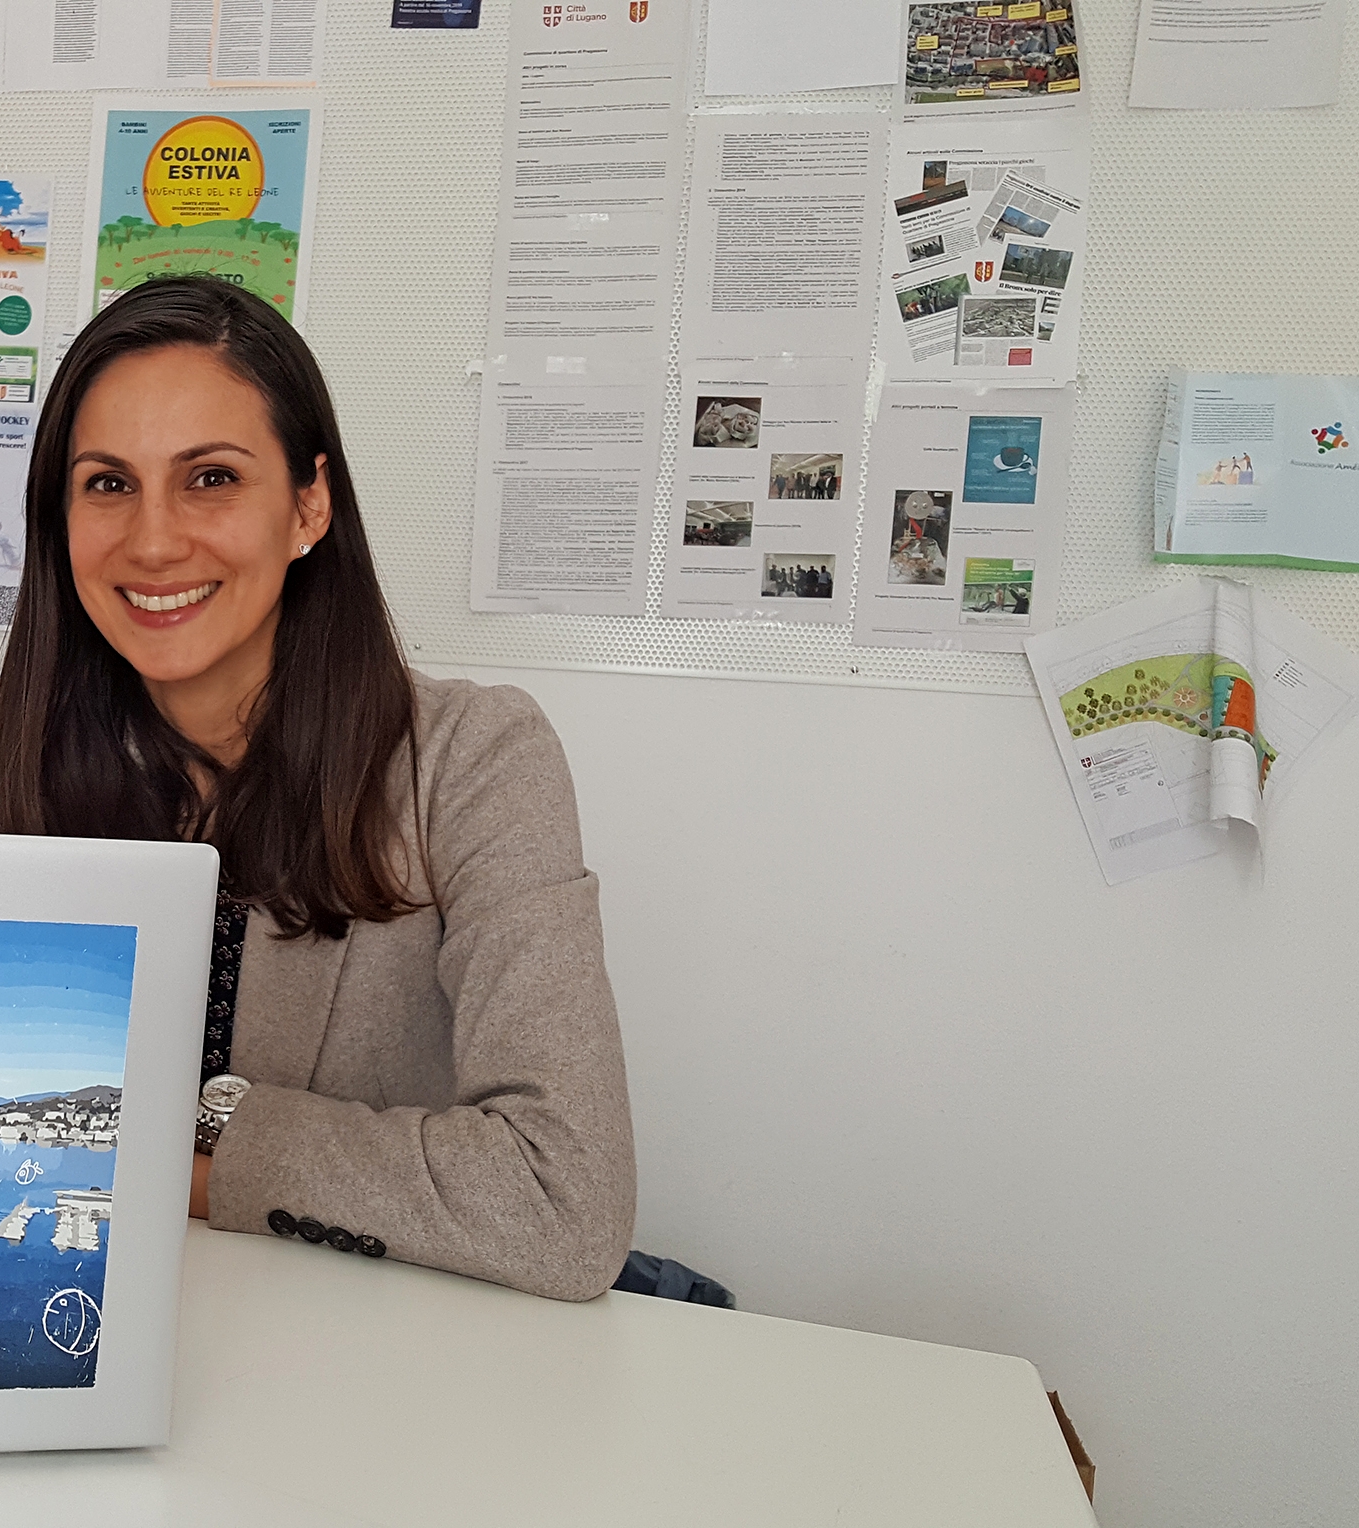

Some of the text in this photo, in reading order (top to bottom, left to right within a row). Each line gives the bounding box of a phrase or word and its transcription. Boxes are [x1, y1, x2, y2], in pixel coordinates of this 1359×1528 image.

[567, 5, 586, 13] Città
[566, 13, 607, 23] di Lugano
[160, 146, 251, 162] COLONIA
[168, 165, 240, 180] ESTIVA
[125, 186, 279, 197] LE AVVENTURE DEL RE LEONE
[0, 282, 24, 293] LEONE
[1024, 286, 1037, 294] solo
